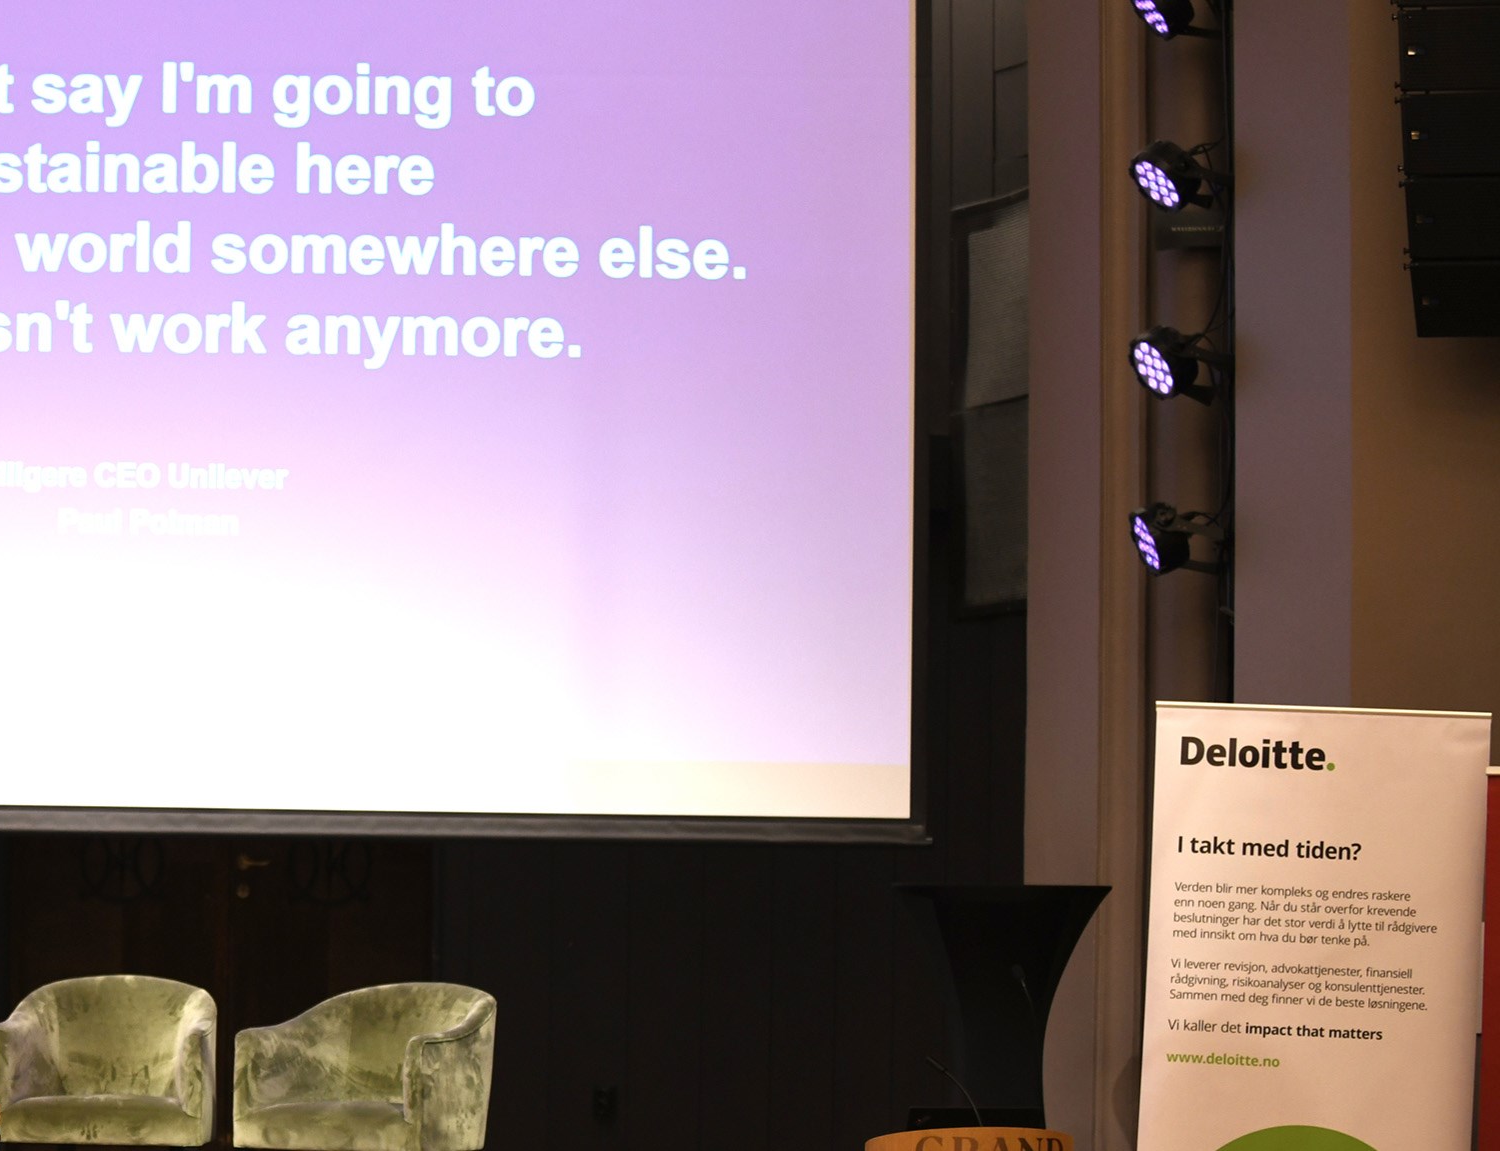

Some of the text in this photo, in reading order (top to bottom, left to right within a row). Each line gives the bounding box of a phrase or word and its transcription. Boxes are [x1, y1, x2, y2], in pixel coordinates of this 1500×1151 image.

[31, 73, 143, 127] say
[161, 61, 252, 114] I'm
[272, 63, 452, 129] going
[471, 66, 536, 117] to
[296, 141, 435, 196] here
[15, 220, 191, 273] world
[210, 222, 580, 278] somewhere
[598, 225, 746, 280] else.
[110, 301, 267, 355] work
[285, 314, 582, 370] anymore.
[94, 462, 161, 489] CEO
[167, 463, 289, 490] Unilever
[1180, 735, 1335, 771] Deloitte.
[1178, 836, 1361, 860] I takt med tiden?
[1175, 882, 1411, 901] Verden blir mer kompleks og endres raskere
[1174, 899, 1416, 917] enn noen gang. Når du står overfor krevende
[1174, 912, 1437, 935] beslutninger har det stor verdi å lytte til rådgivere
[1173, 928, 1370, 948] med innsikt om hva du bør tenke på.
[1171, 958, 1412, 978] Vi leverer revisjon, advokattjenester, finansiell
[1170, 973, 1425, 995] rådgivning, risikoanalyser og konsulenttjenester.
[1170, 989, 1427, 1012] Sammen med deg finner vi de beste løsningene.
[1168, 1019, 1383, 1040] Vi kaller det impact that matters
[1167, 1053, 1280, 1067] www.deloitte.no
